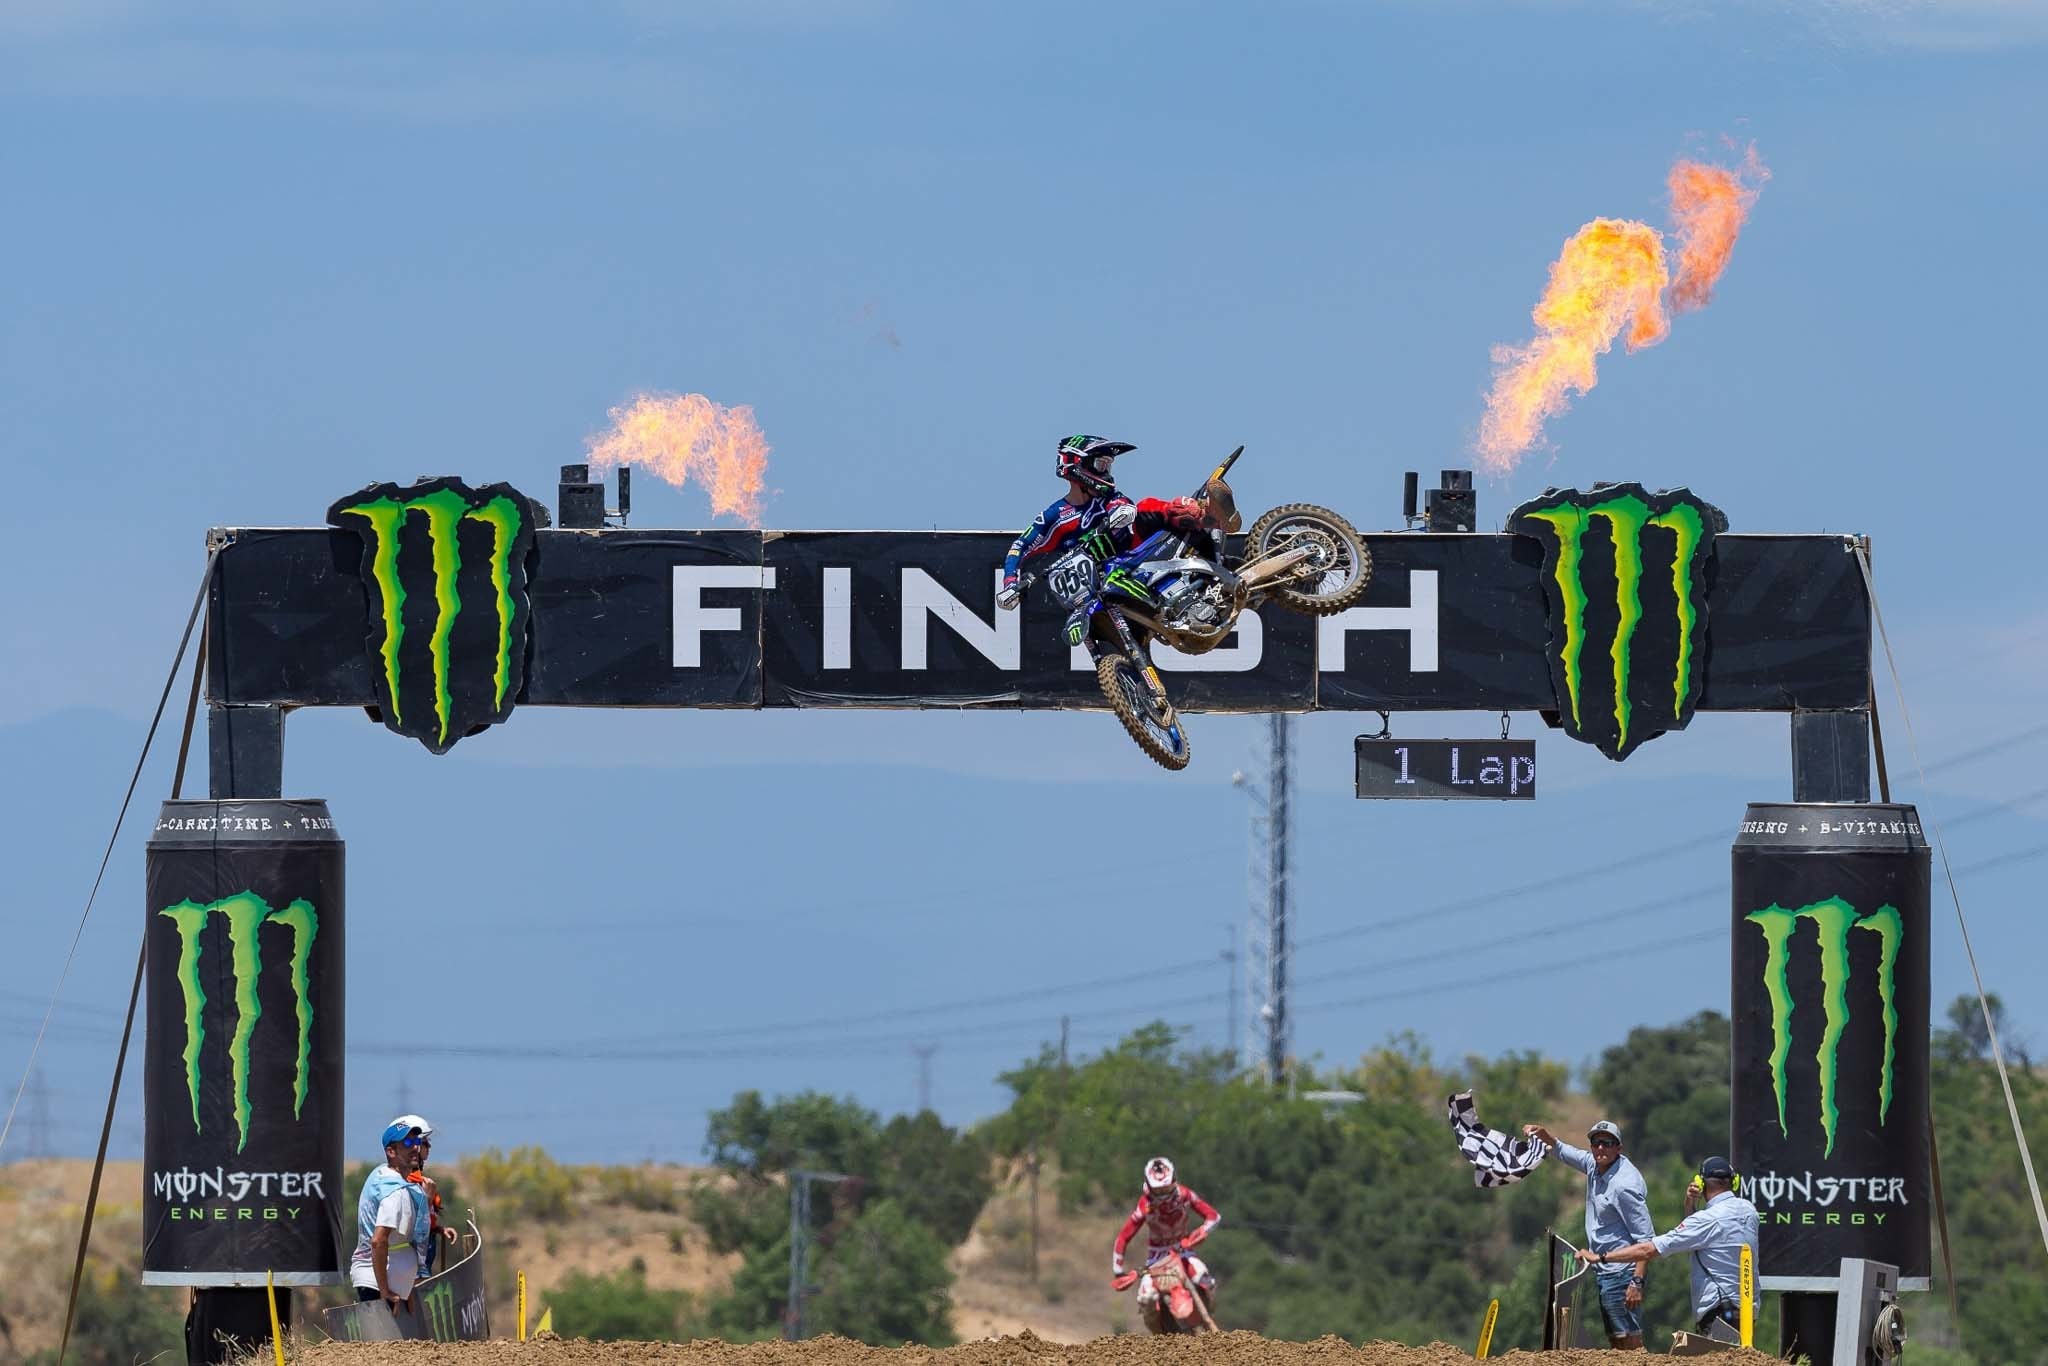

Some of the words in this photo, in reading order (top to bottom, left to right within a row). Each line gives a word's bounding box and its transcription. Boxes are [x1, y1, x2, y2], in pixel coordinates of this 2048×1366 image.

[1054, 559, 1093, 600] 959
[1394, 747, 1415, 785] 1
[1451, 747, 1535, 795] Lap
[153, 1166, 325, 1203] MONSTER
[1740, 1170, 1908, 1207] MONSTER
[171, 1207, 300, 1220] ENERGY
[1758, 1212, 1886, 1225] ENERGY
